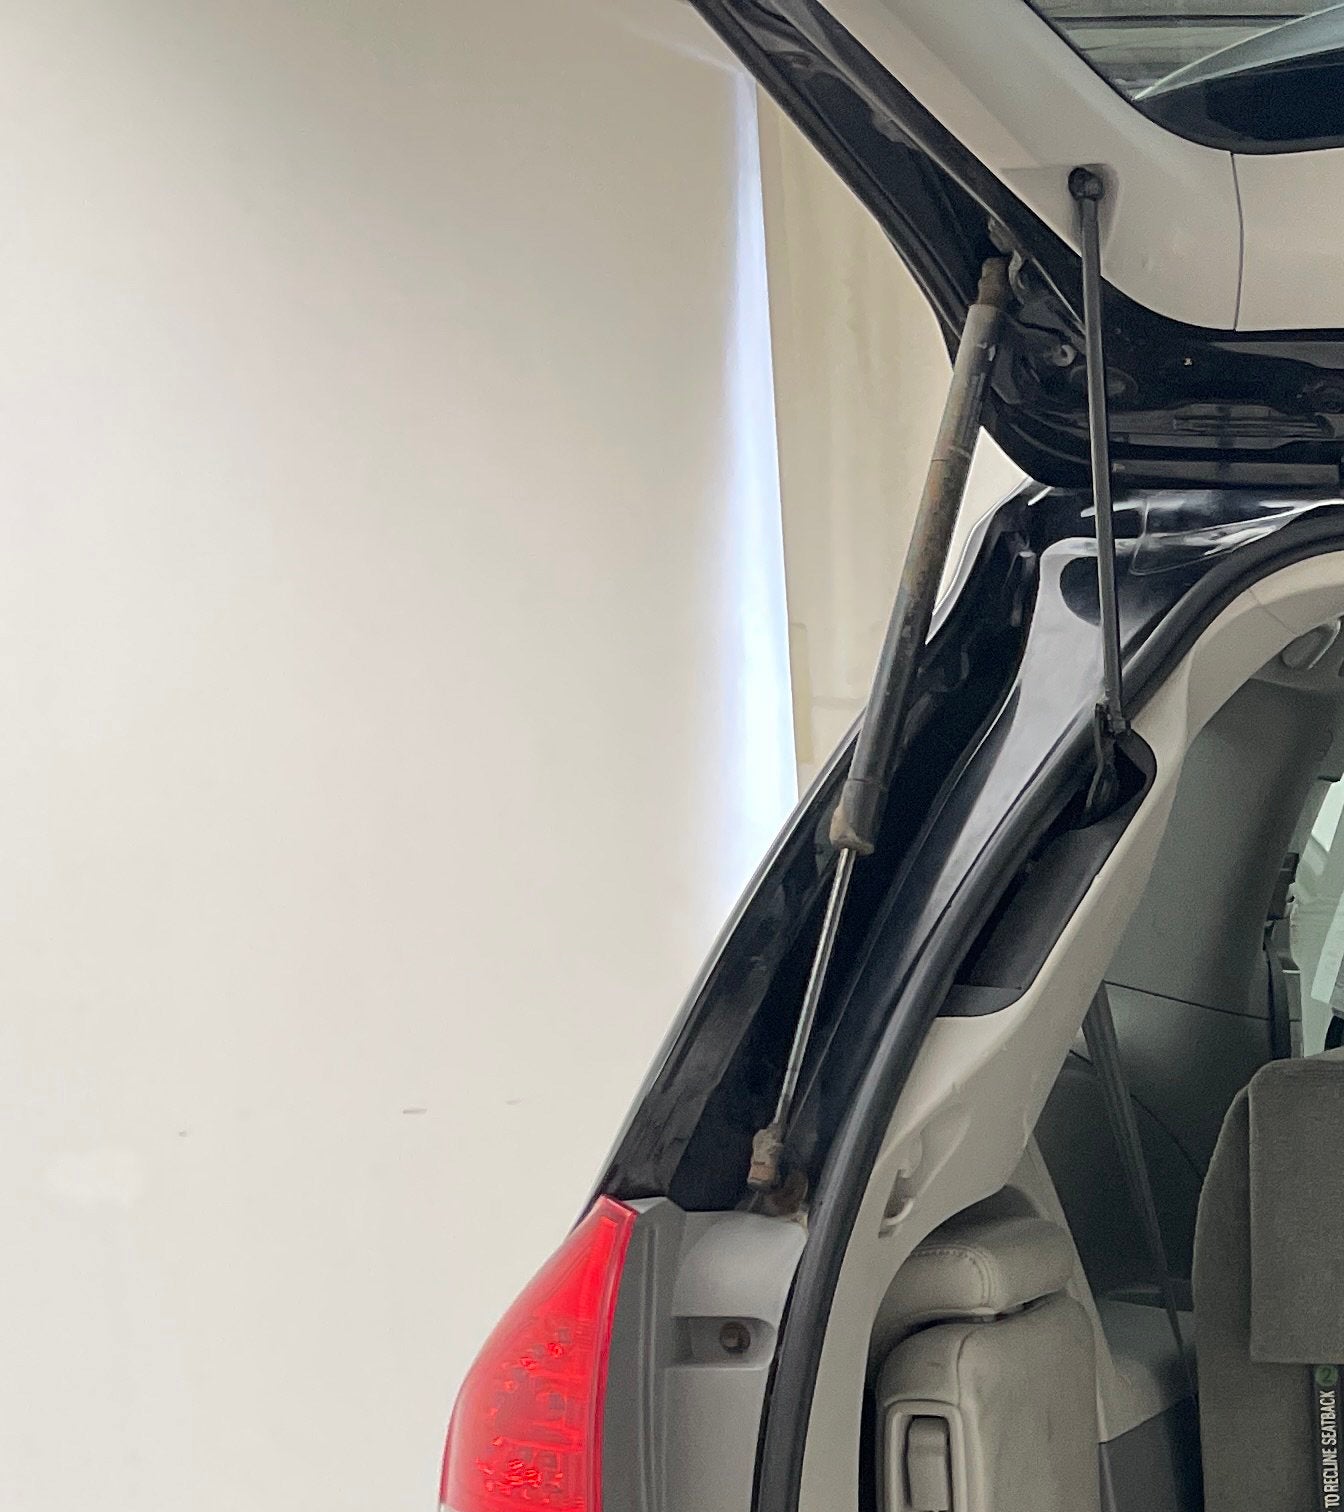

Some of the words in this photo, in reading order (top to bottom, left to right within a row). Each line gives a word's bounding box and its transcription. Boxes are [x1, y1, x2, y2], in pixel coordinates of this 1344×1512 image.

[1319, 1390, 1337, 1446] SEATBACK
[1322, 1448, 1340, 1492] RECLINE
[1324, 1494, 1341, 1509] TO
